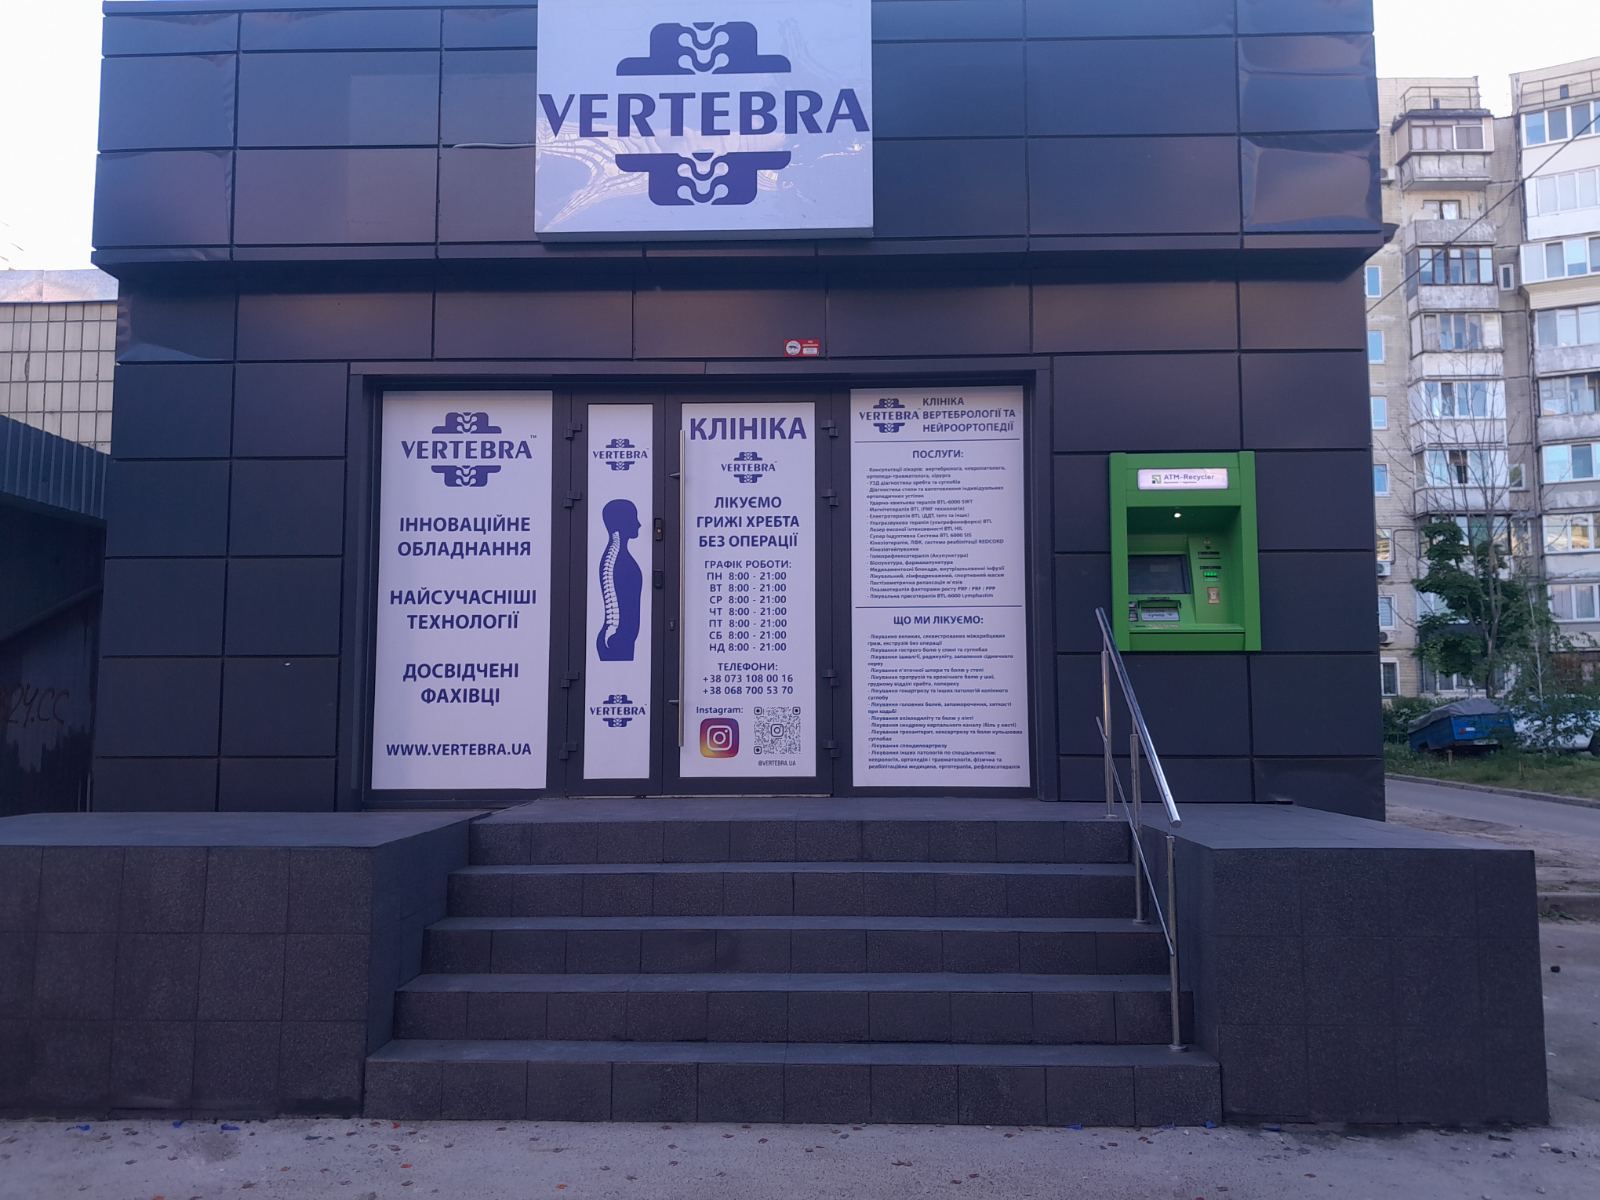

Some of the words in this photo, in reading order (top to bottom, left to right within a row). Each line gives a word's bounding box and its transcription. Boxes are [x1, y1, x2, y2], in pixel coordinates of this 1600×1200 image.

[539, 88, 870, 137] VERTEBRA
[923, 397, 964, 406] КЛІНІКА
[860, 411, 919, 420] VERTEBRA
[923, 408, 1001, 419] ВЕРТЕБРОЛОГІЇ
[1003, 409, 1015, 417] ТА
[691, 417, 807, 440] КЛІНІКА
[923, 421, 1013, 432] НЕЙРООРТОПЕДІЇ
[401, 441, 532, 459] VERTEBRA
[593, 450, 648, 459] VERTEBRA
[913, 450, 963, 458] ПОСЛУГИ:
[721, 463, 776, 472] VERTEBRA
[1164, 474, 1214, 482] ATM-Recycler
[714, 497, 781, 508] ЛІКУЄМО
[400, 514, 530, 535] ІННОВАЦІЙНЕ
[697, 516, 742, 527] ГРИЖІ
[746, 516, 799, 527] ХРЕБТА
[699, 536, 725, 547] БЕЗ
[729, 533, 798, 549] ОПЕРАЦІЇ
[398, 542, 530, 559] ОБЛАДНАННЯ
[705, 560, 742, 568] ГРАФІК
[746, 560, 791, 568] РОБОТИ:
[707, 572, 722, 580] ПН
[729, 572, 749, 580] 8:00
[760, 572, 786, 580] 21:00
[710, 584, 722, 592] ВТ
[728, 584, 749, 592] 8:00
[760, 583, 786, 592] 21:00
[391, 587, 536, 604] НАЙСУЧАСНІШІ
[710, 596, 722, 604] СР
[729, 596, 749, 604] 8:00
[760, 595, 786, 603] 21:00
[710, 608, 723, 616] ЧТ
[729, 608, 749, 616] 8:00
[760, 607, 787, 615] 21:00
[407, 611, 519, 629] ТЕХНОЛОГІЇ
[709, 619, 723, 627] ПТ
[729, 619, 750, 627] 8:00
[760, 619, 787, 627] 21:00
[894, 616, 911, 626] ЩО
[914, 616, 930, 624] МИ
[933, 616, 983, 624] ЛІКУЄМО:
[709, 631, 722, 639] СБ
[729, 631, 749, 639] 8:00
[760, 631, 786, 639] 21:00
[710, 643, 724, 653] НД
[728, 643, 749, 651] 8:00
[760, 643, 786, 651] 21:00
[718, 663, 778, 671] ТЕЛЕФОНИ:
[403, 663, 518, 682] ДОСВІДЧЕНІ
[703, 675, 721, 683] +38
[725, 674, 742, 683] 073
[746, 674, 763, 683] 108
[766, 674, 778, 682] 00
[782, 674, 793, 682] 16
[724, 686, 742, 694] 068
[746, 686, 763, 694] 700
[767, 686, 778, 694] 53
[782, 686, 793, 694] 70
[421, 688, 499, 706] ФАХІВЦІ
[590, 706, 646, 715] VERTEBRA
[697, 706, 743, 715] Instagram:
[387, 743, 531, 756] WWW.VERTEBRA.UA
